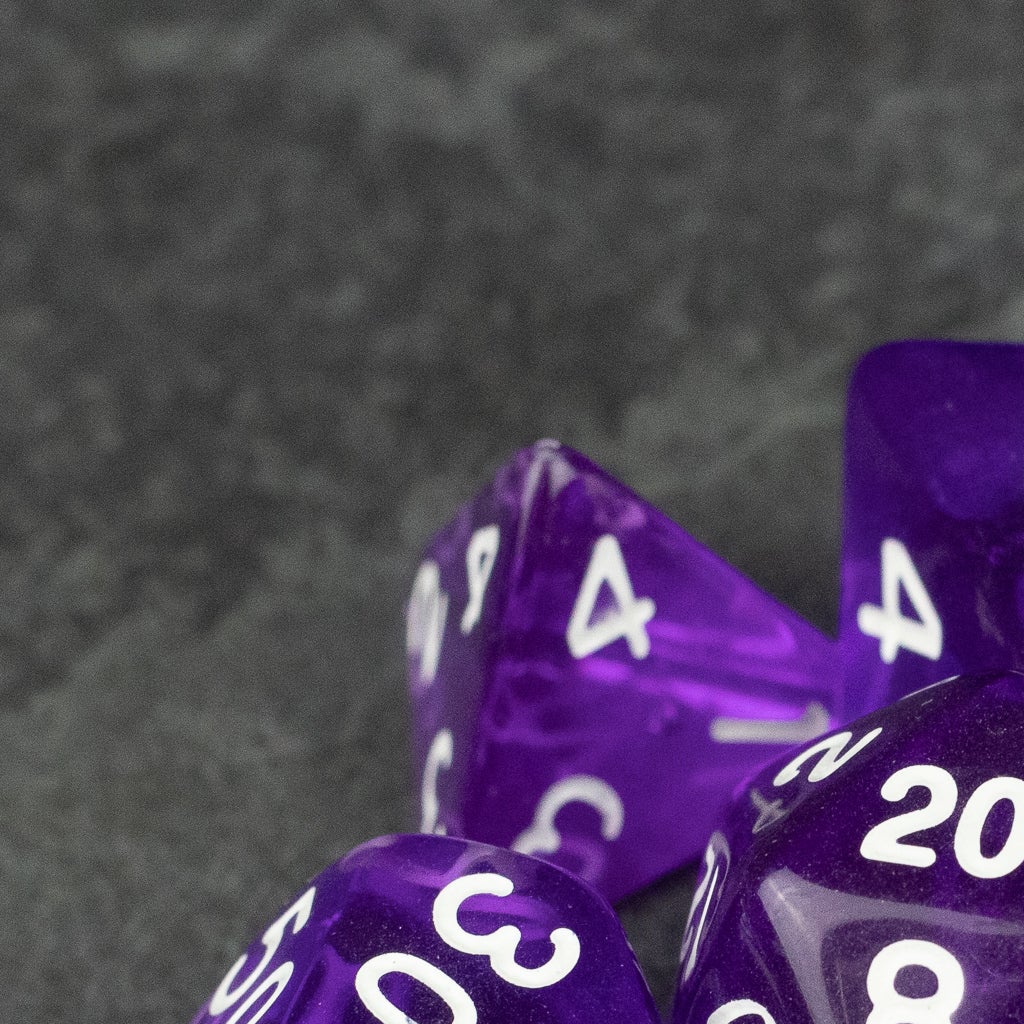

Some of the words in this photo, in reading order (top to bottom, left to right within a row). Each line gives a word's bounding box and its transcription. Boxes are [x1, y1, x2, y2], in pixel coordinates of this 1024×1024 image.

[567, 534, 657, 660] 4
[857, 537, 943, 664] 4
[773, 727, 883, 786] 2
